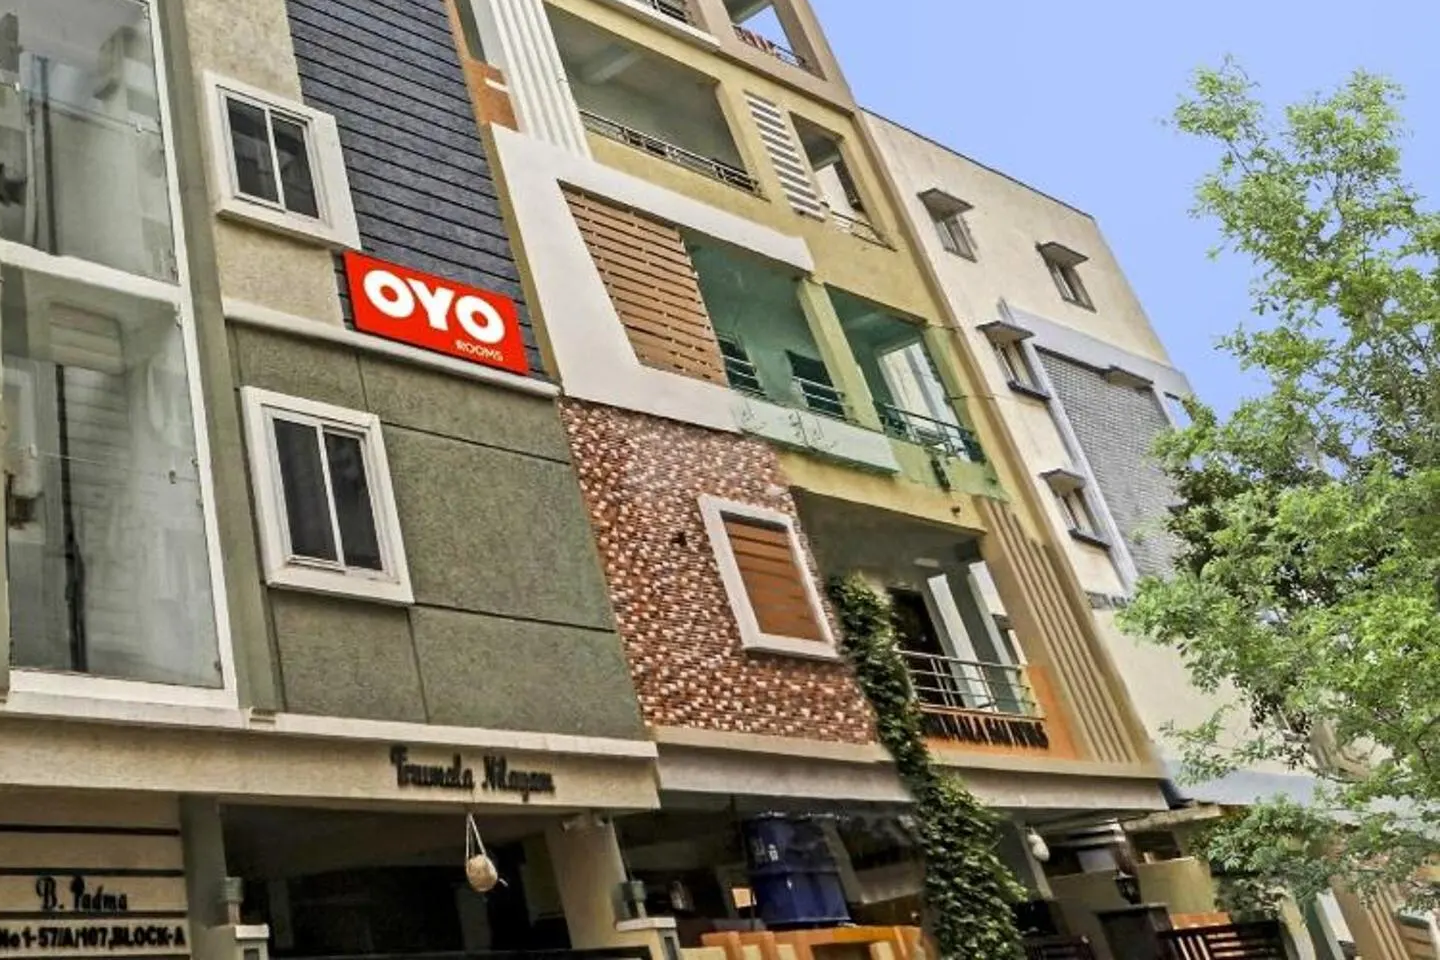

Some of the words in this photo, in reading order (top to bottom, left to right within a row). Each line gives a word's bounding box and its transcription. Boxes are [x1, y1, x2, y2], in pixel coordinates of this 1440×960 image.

[362, 269, 506, 344] OYO
[454, 340, 504, 362] ROOMS
[35, 875, 64, 911] B.
[70, 874, 128, 912] Padma
